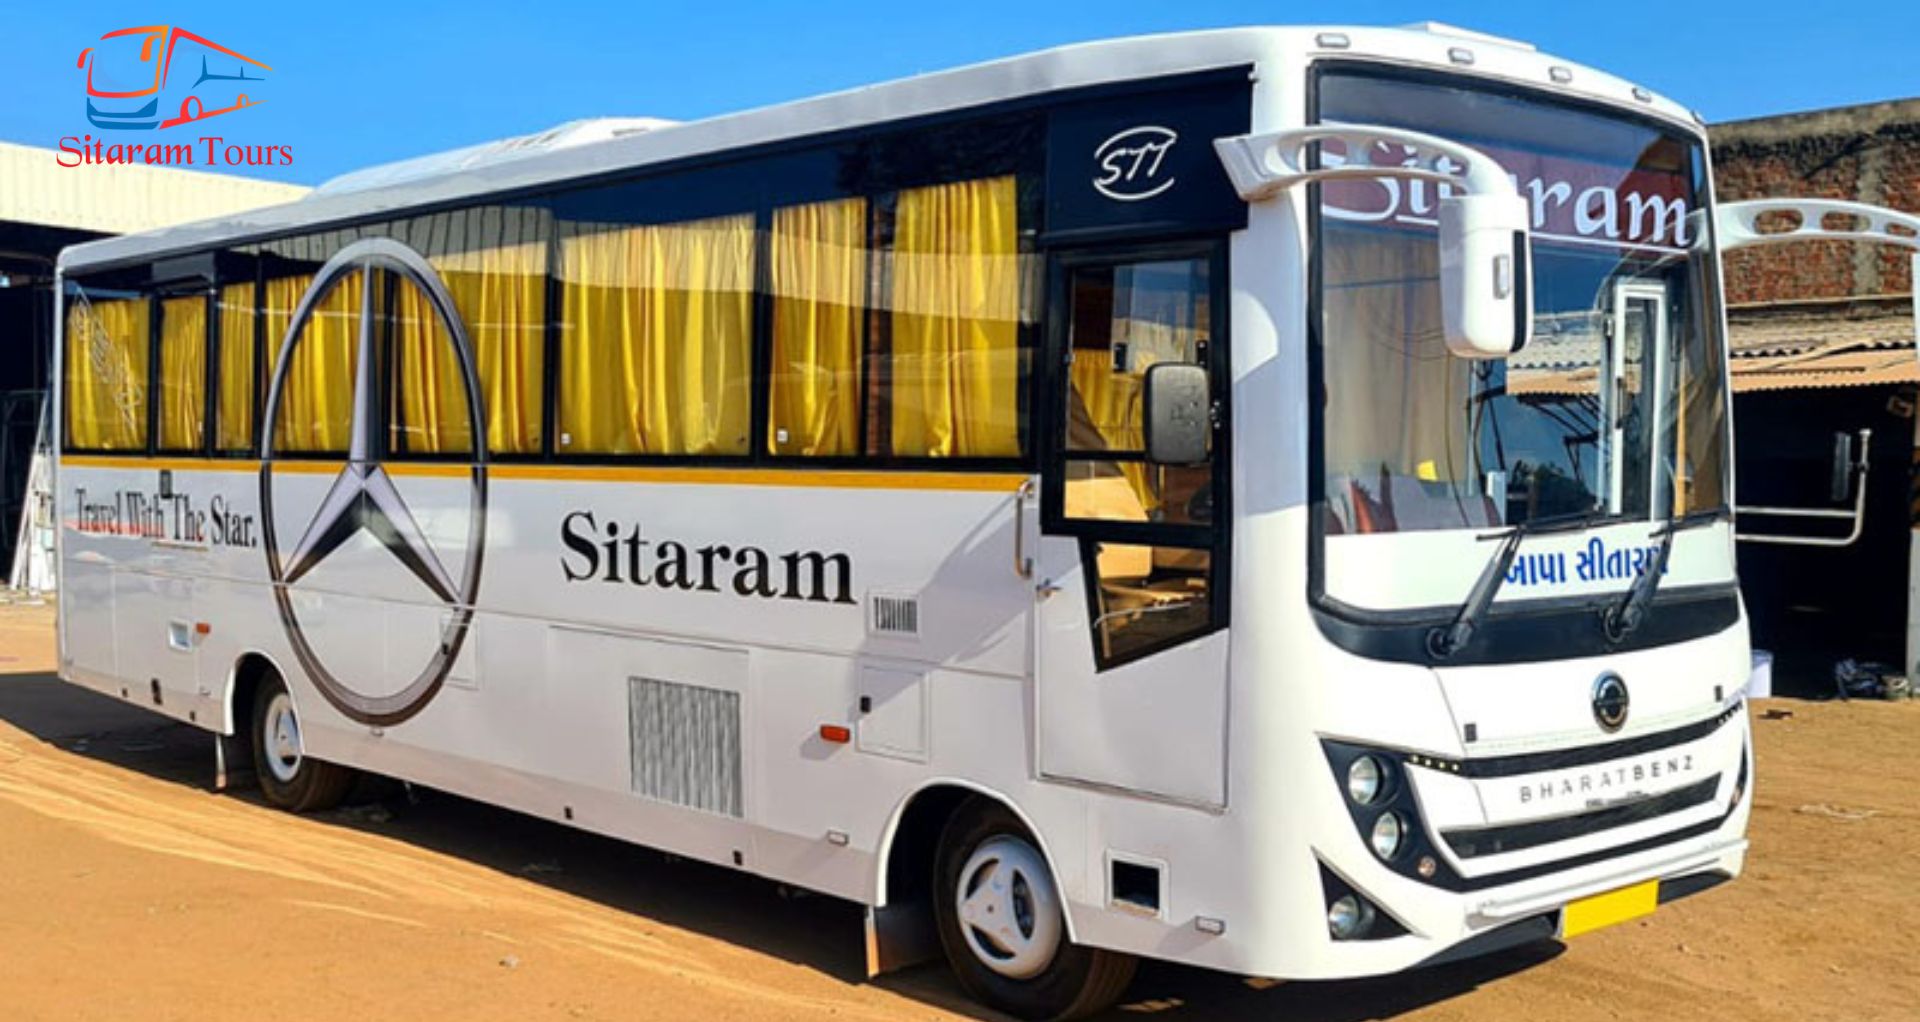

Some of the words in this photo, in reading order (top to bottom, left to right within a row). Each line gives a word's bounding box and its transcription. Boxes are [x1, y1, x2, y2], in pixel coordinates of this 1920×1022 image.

[75, 489, 122, 535] Travel
[126, 491, 165, 538] With
[172, 493, 206, 542] The
[210, 494, 257, 547] Star.
[560, 509, 858, 605] Sitaram
